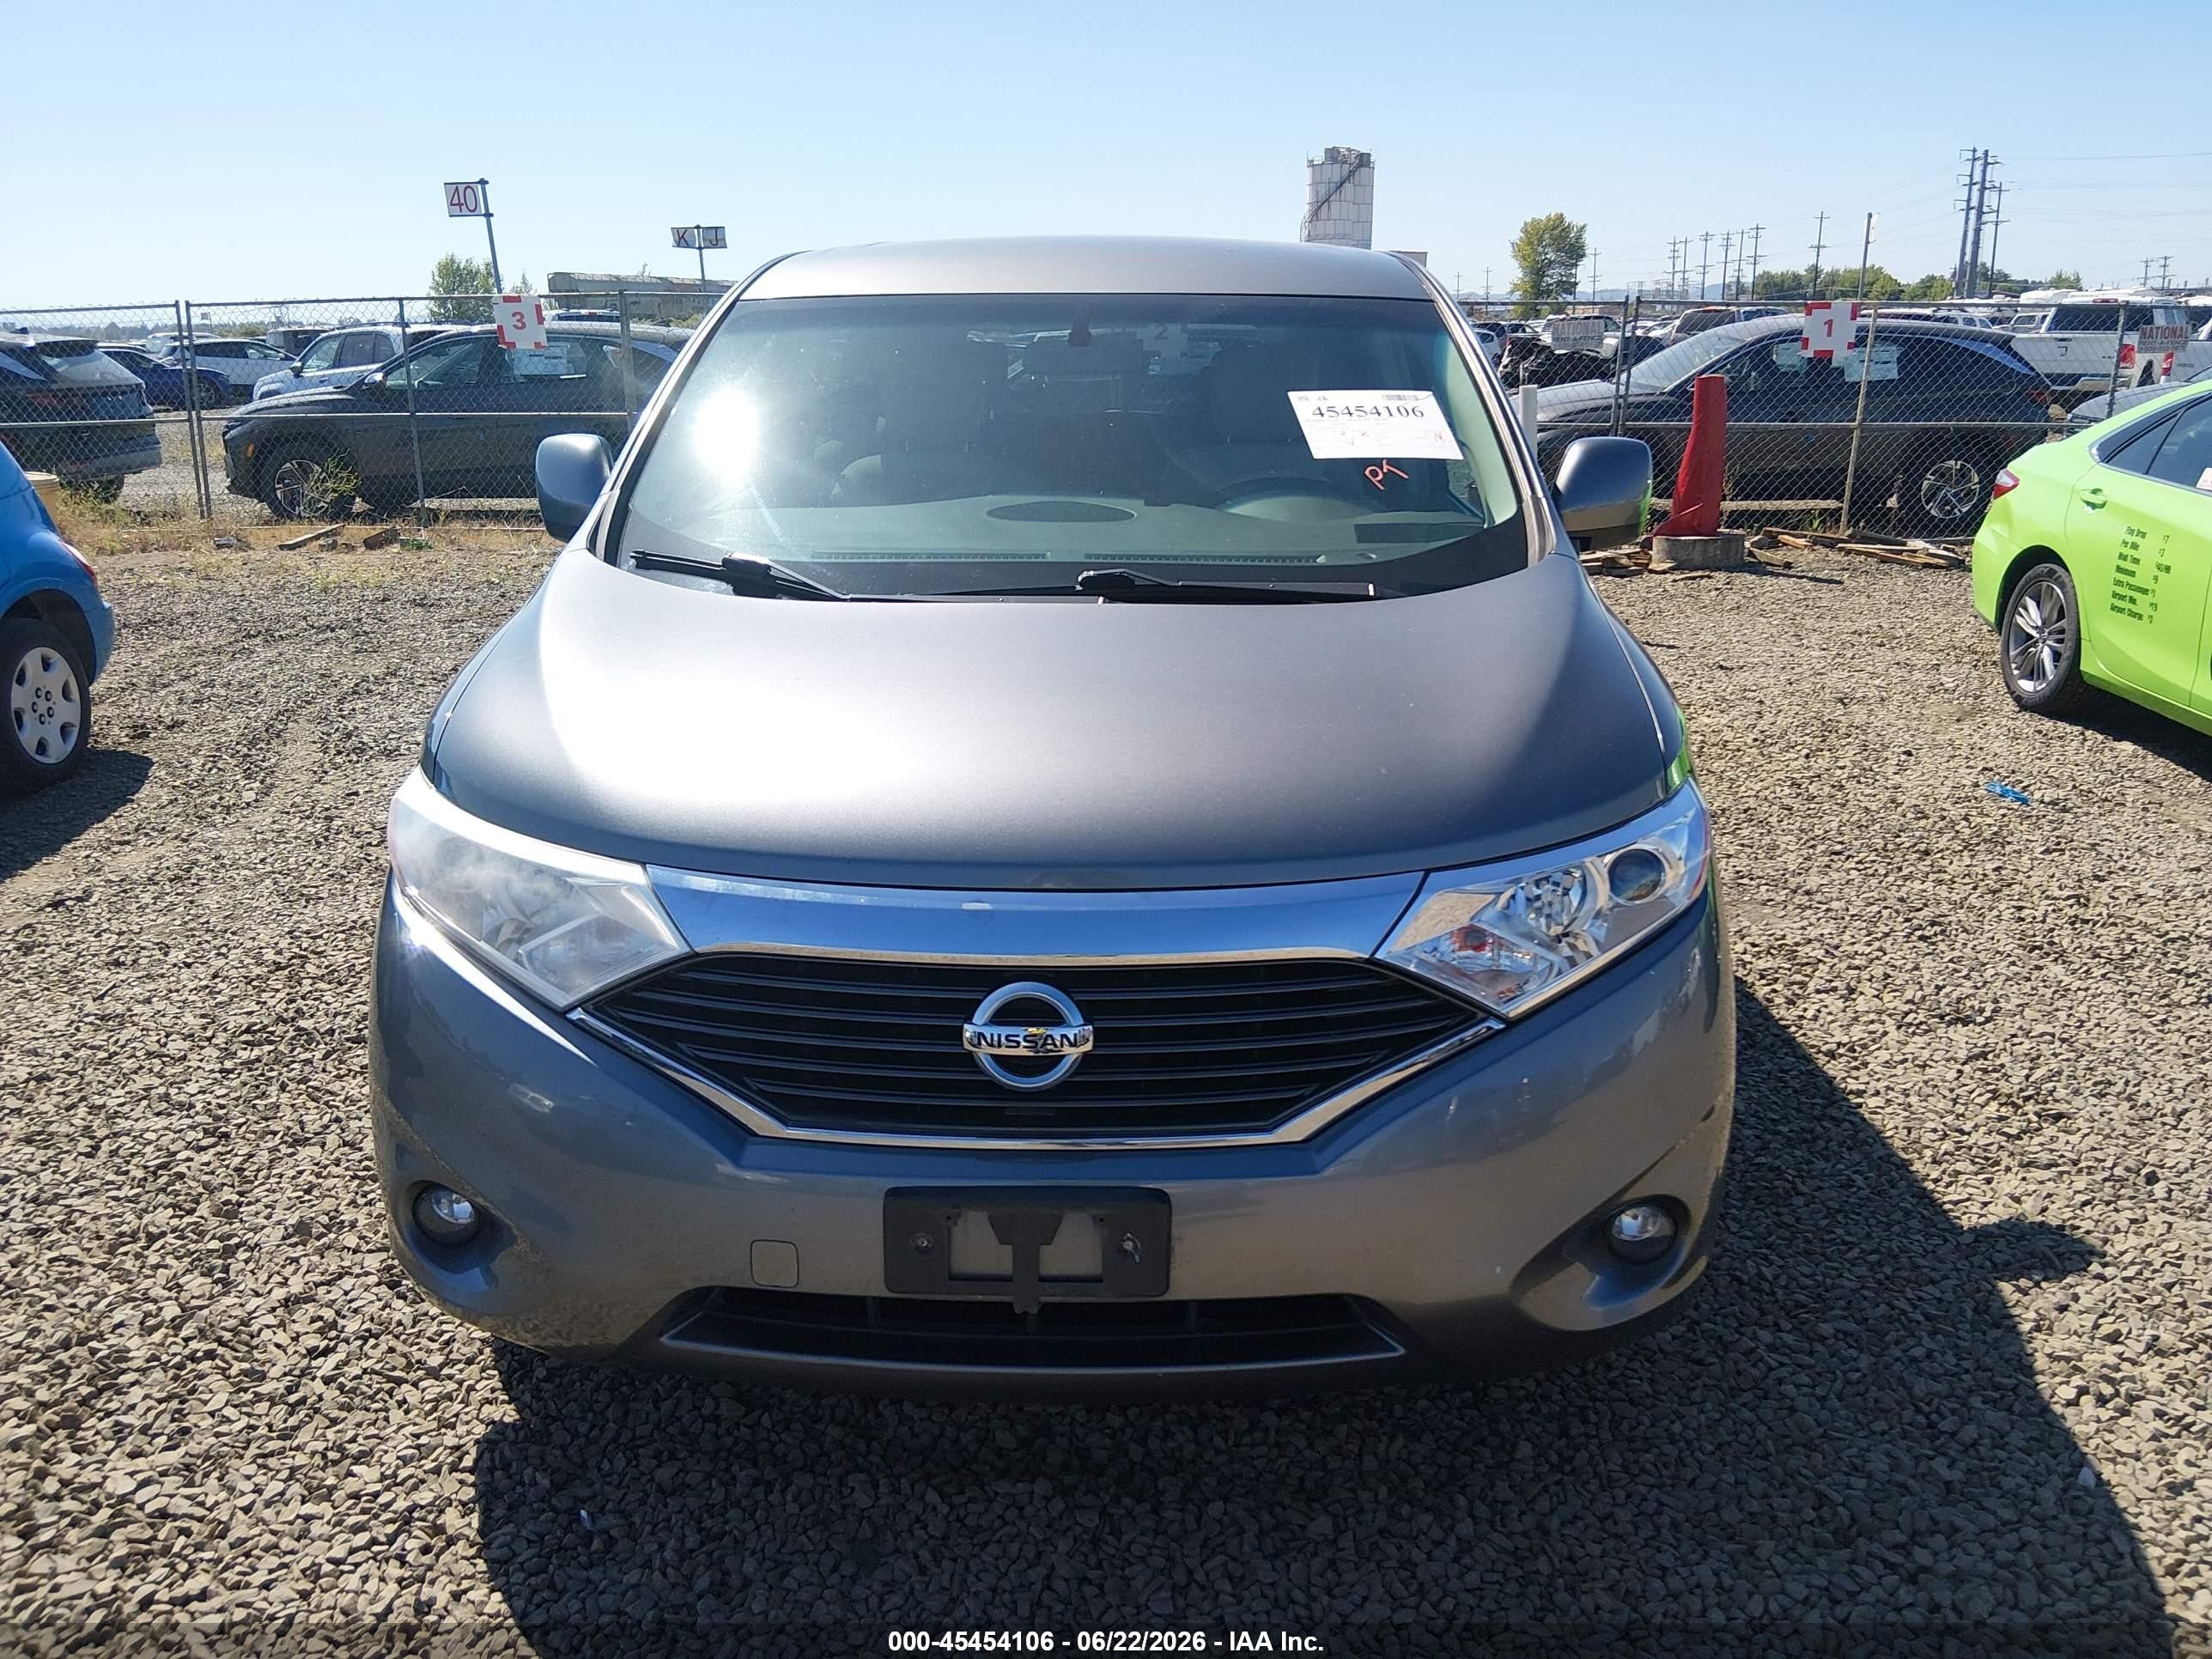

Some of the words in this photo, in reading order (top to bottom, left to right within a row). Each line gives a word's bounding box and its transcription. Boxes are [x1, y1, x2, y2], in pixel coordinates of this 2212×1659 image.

[449, 185, 478, 213] 40
[676, 228, 690, 246] K
[708, 228, 719, 246] J
[511, 311, 526, 331] 3
[1823, 319, 1833, 337] 1
[1154, 323, 1169, 340] 2
[2141, 325, 2190, 340] NATIONAL
[1312, 404, 1425, 419] 45454106
[2121, 538, 2130, 548] Per
[976, 1031, 1079, 1049] NISSAN
